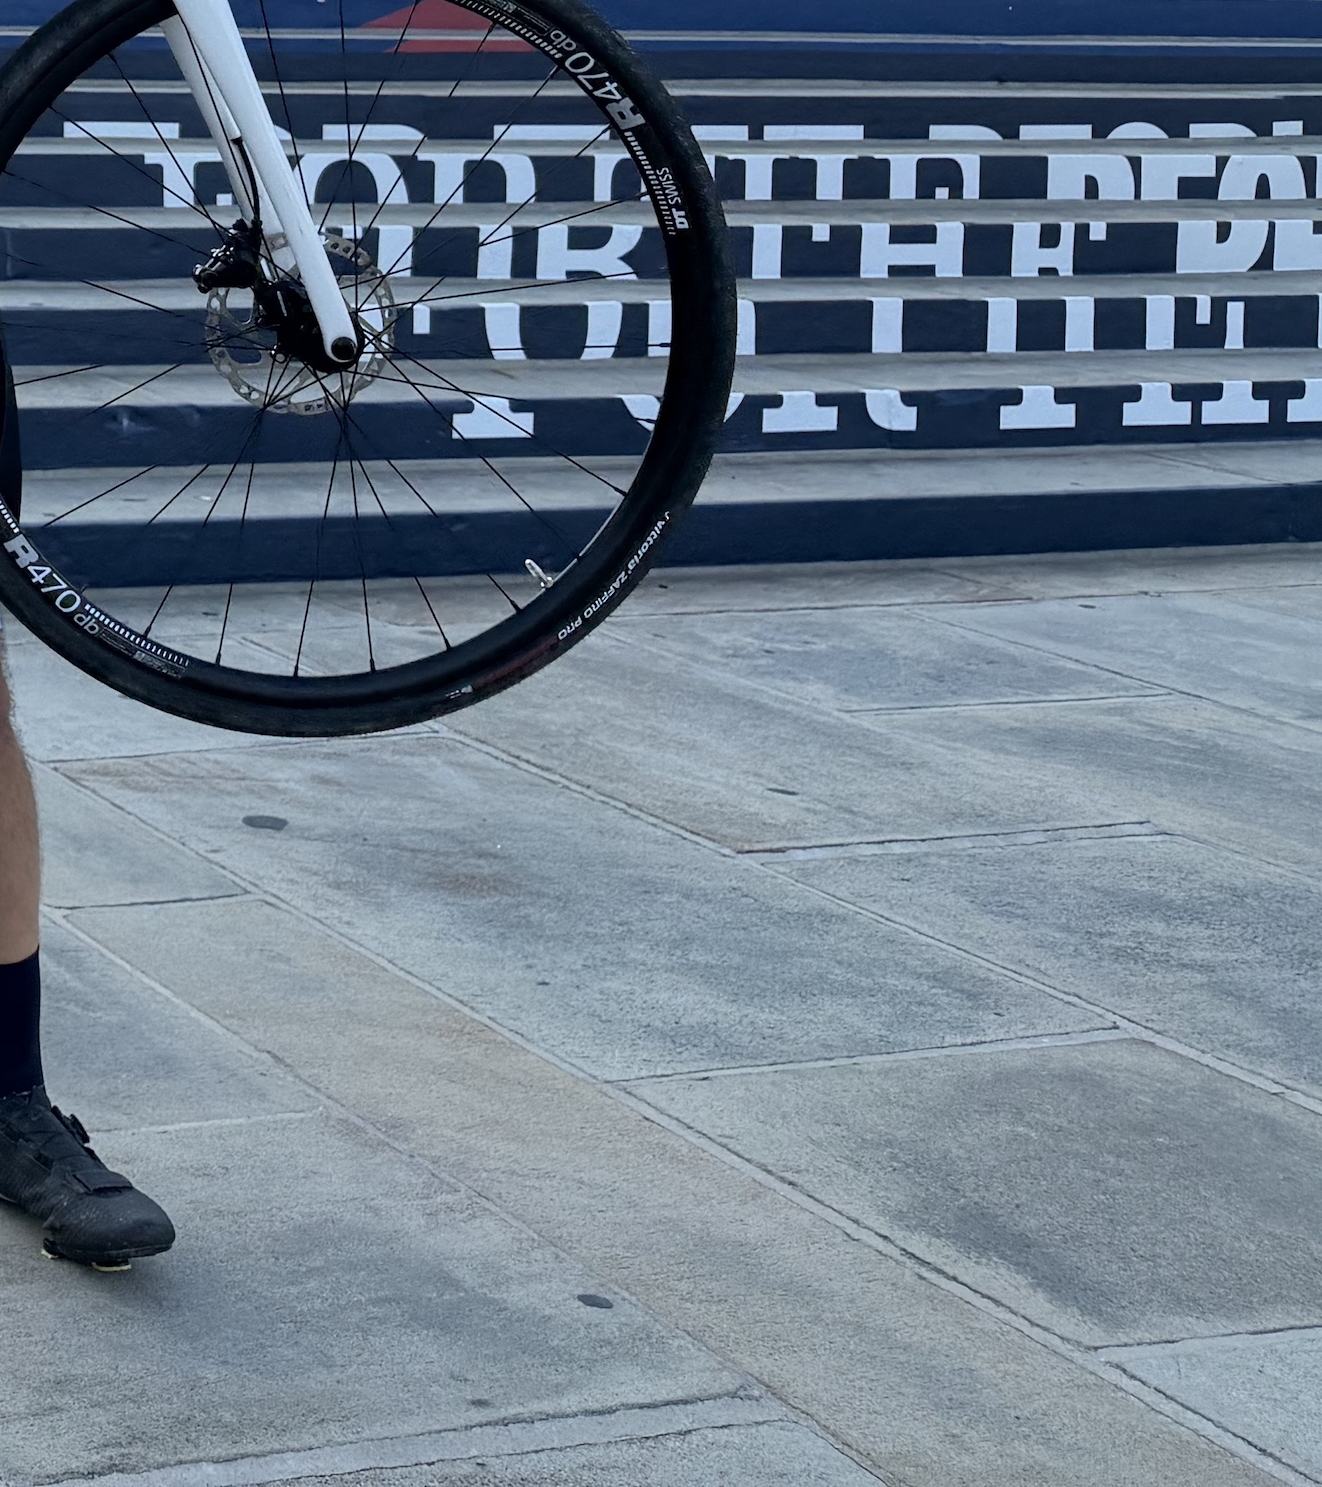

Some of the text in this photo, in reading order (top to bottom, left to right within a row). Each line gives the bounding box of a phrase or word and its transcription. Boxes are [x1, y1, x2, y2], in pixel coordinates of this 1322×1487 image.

[550, 29, 577, 51] db
[656, 166, 690, 230] DT SWISS
[557, 520, 666, 641] vittoria ZAFFIRO PRO
[73, 612, 100, 635] db
